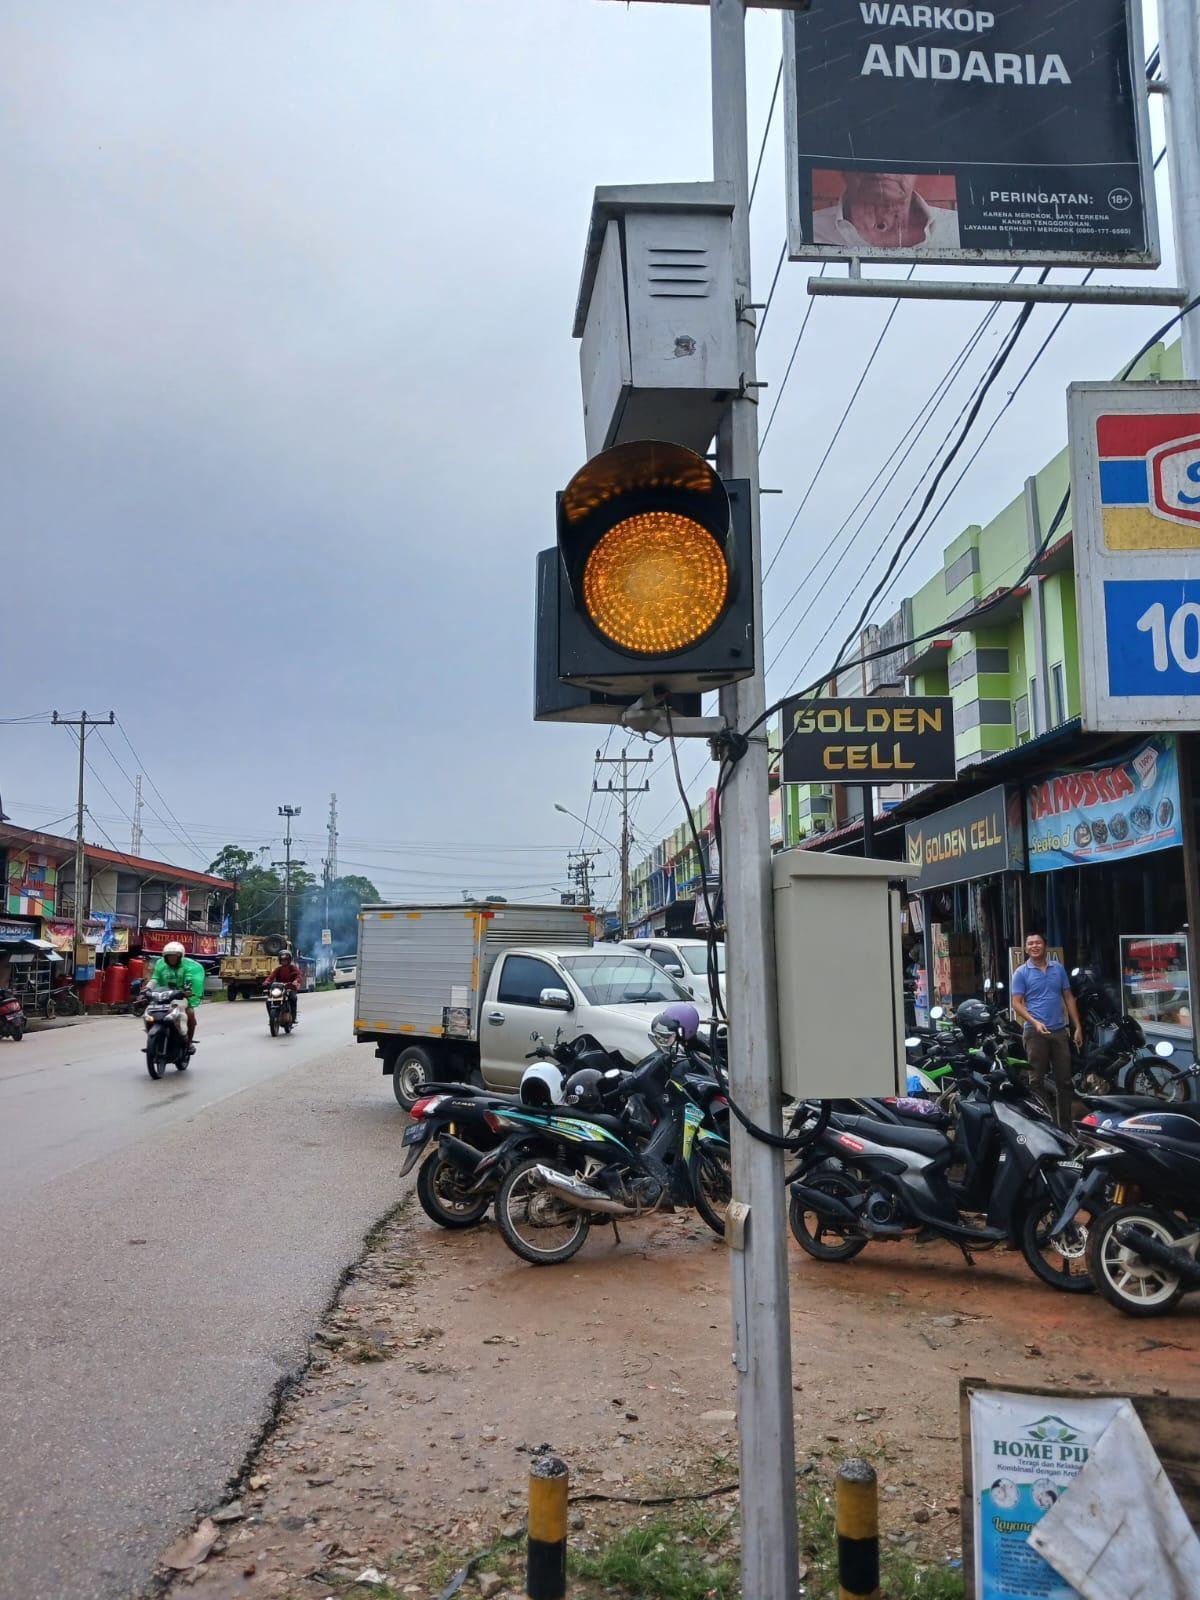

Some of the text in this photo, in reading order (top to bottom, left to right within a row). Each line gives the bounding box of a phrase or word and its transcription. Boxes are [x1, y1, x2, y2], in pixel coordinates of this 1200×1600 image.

[859, 2, 995, 32] WARKOP
[861, 43, 1072, 85] ANDARIA
[990, 191, 1094, 204] PERINGATAN:
[1136, 602, 1200, 673] 10
[793, 706, 942, 735] GOLDEN
[823, 742, 916, 770] CELL
[925, 813, 1002, 864] GOLDEN CELL
[993, 1439, 1053, 1460] HOME
